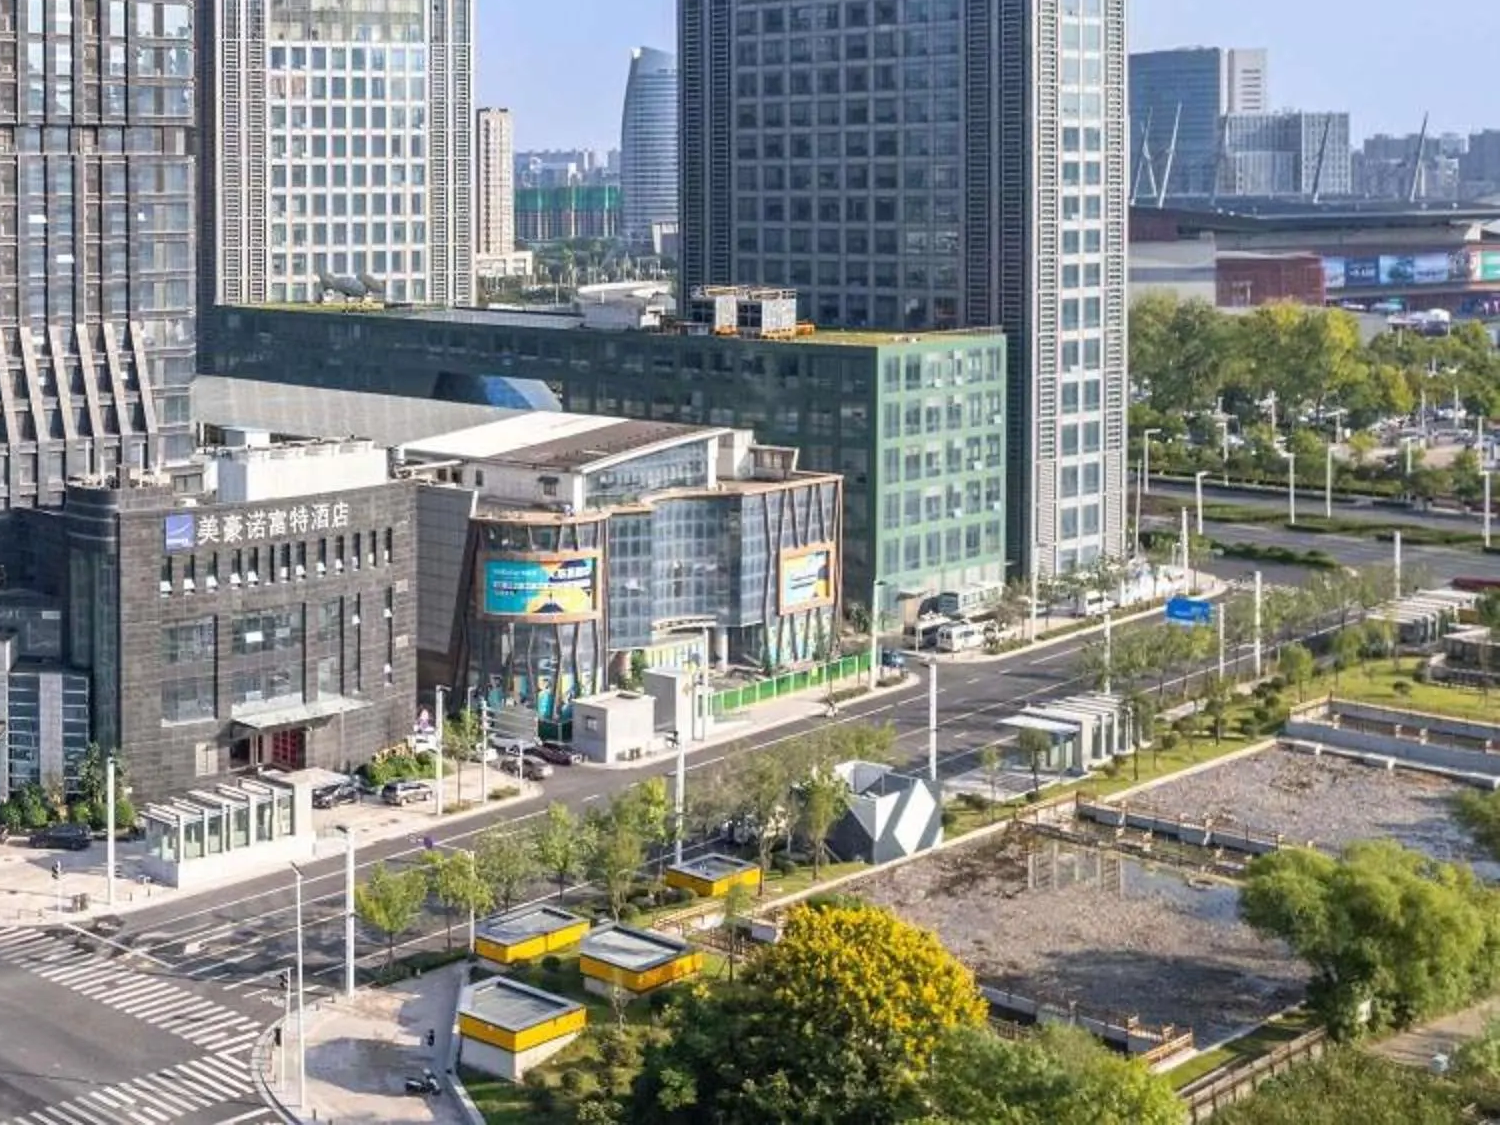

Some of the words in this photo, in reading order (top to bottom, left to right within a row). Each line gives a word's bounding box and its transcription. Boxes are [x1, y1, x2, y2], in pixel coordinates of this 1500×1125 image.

[196, 501, 350, 545] 美豪诺富特酒店
